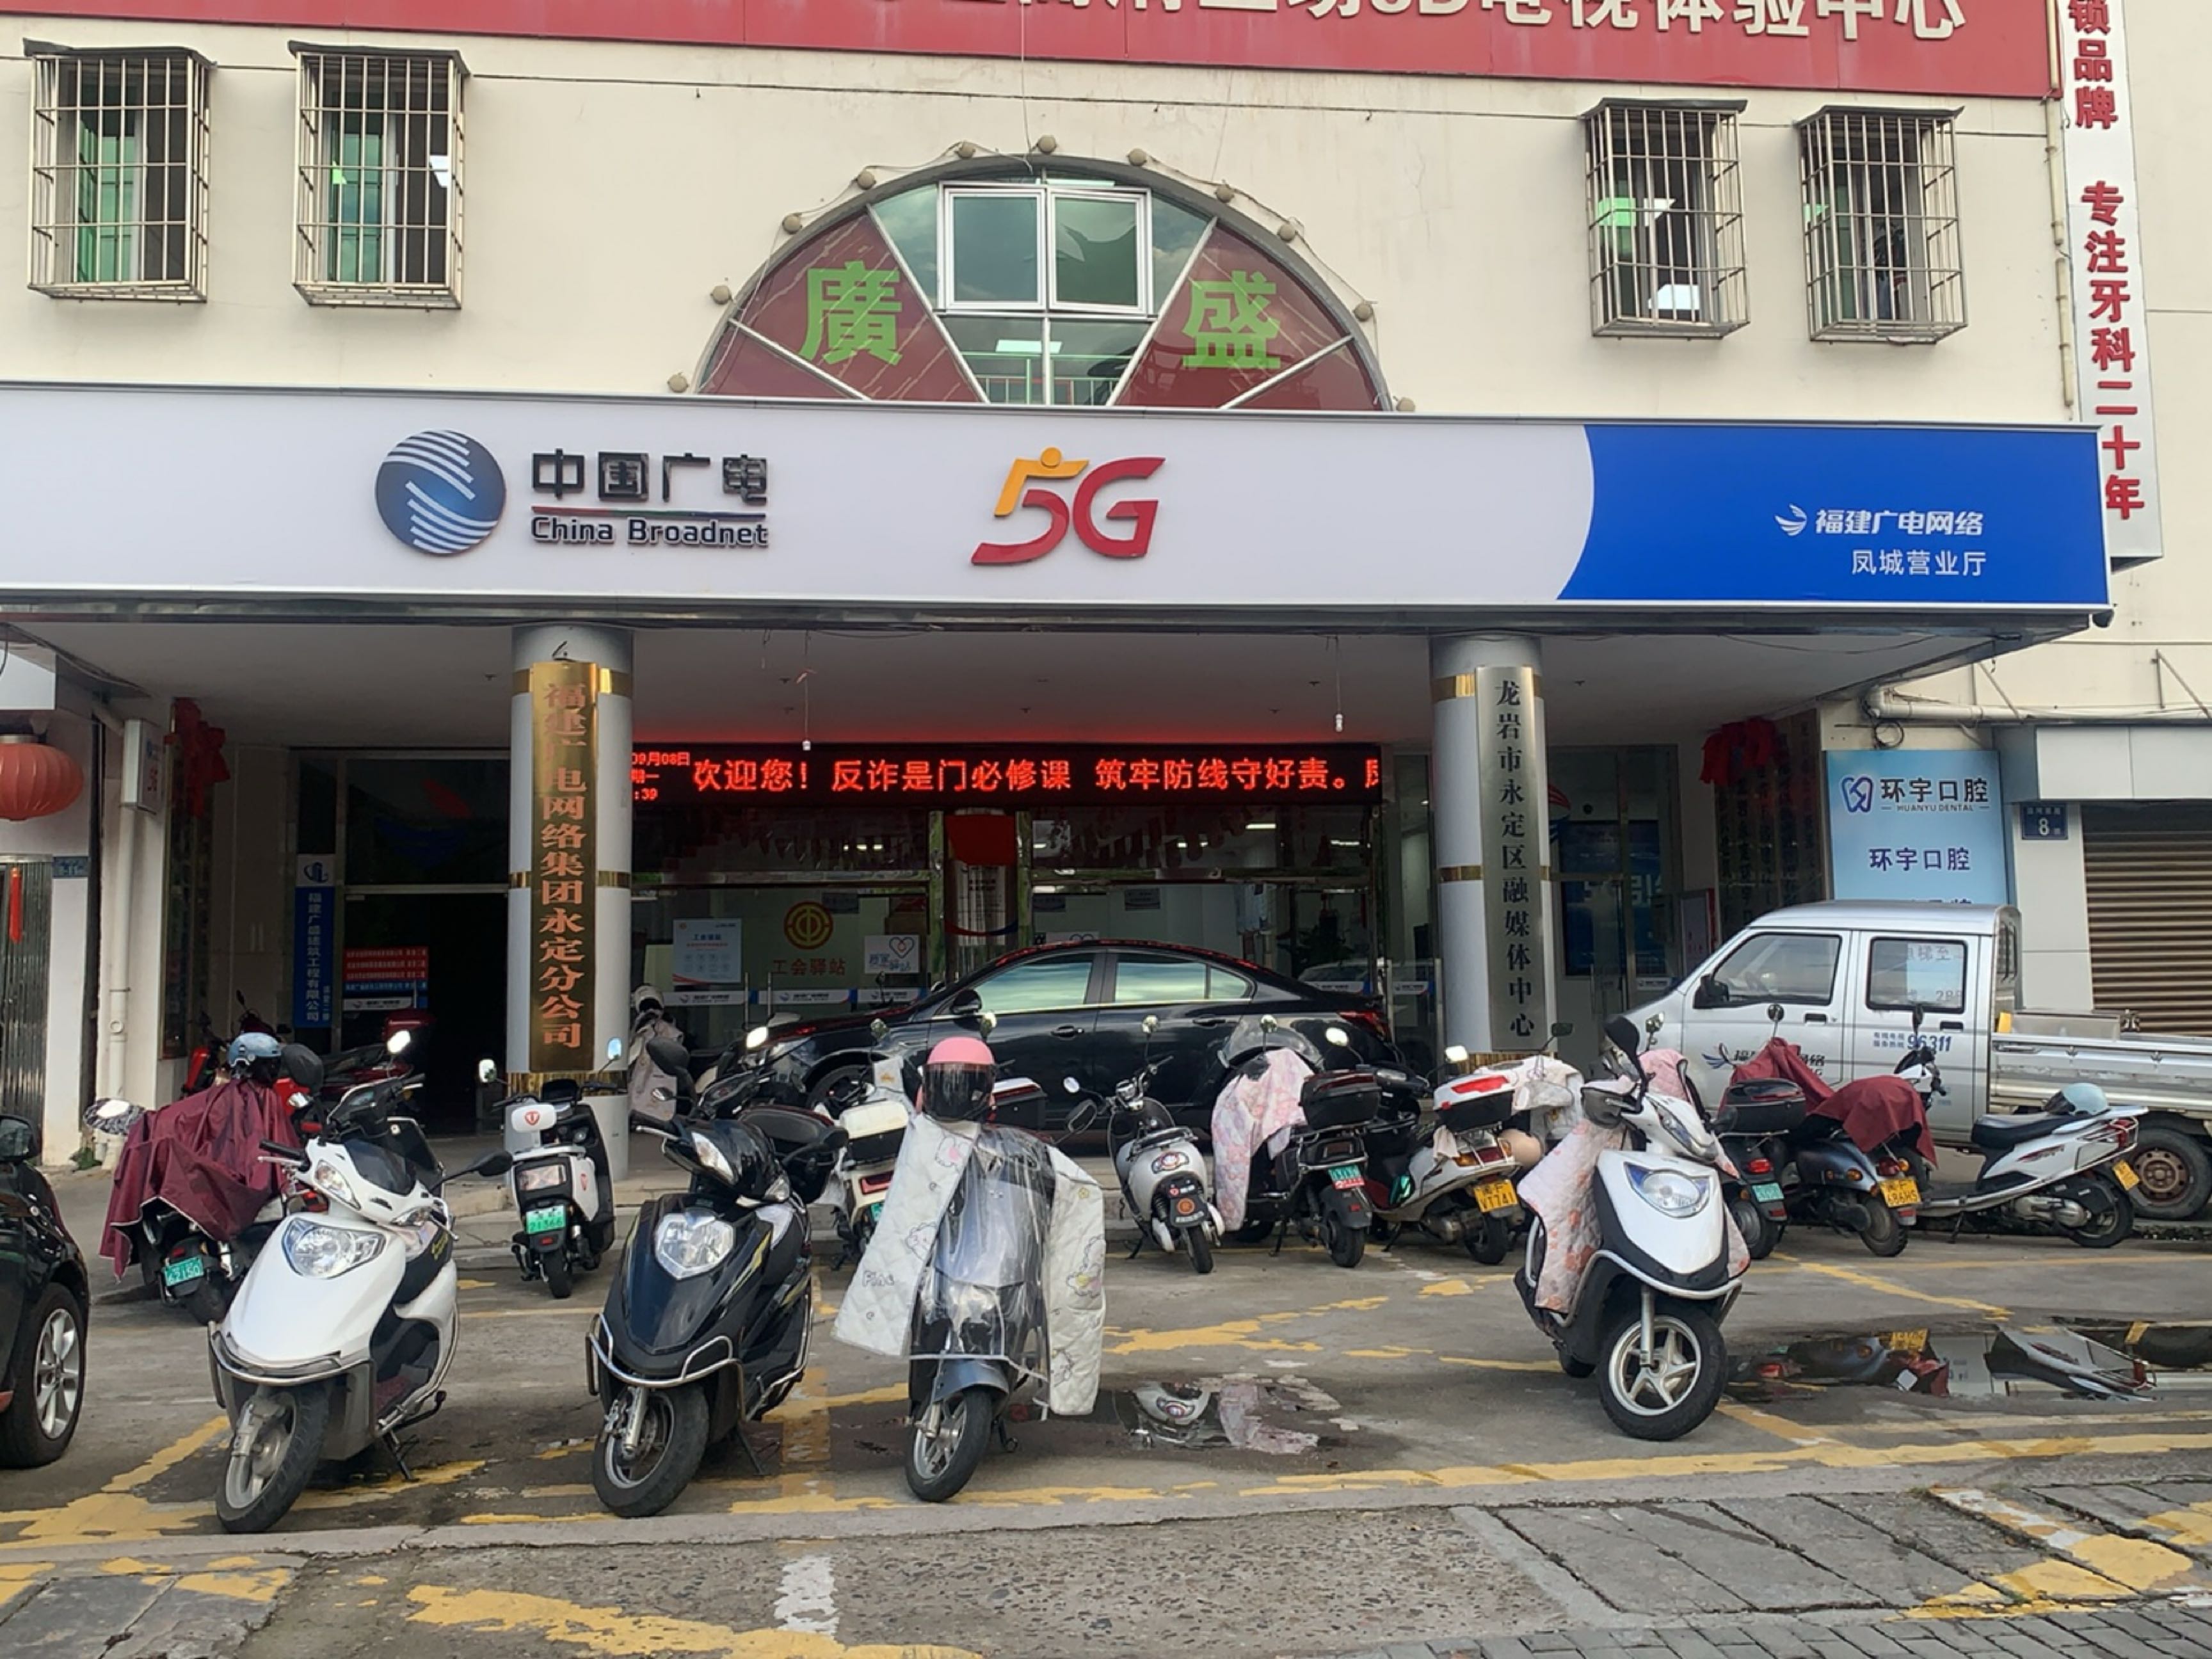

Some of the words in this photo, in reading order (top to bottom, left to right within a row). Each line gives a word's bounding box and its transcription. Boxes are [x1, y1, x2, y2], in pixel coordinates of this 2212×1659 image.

[798, 260, 902, 367] 廣
[1182, 270, 1279, 370] 盛
[2081, 181, 2145, 520] 专注牙科二十年
[532, 447, 767, 506] 中国广电
[970, 447, 1166, 566] 5G
[1815, 509, 1984, 536] 福建广电网络
[531, 517, 614, 543] China
[627, 519, 769, 548] Broadnet
[1852, 549, 1986, 576] 凤城营业厅
[831, 758, 1071, 792] 反诈是门必修课
[1880, 777, 1989, 803] 环宇口腔
[1495, 679, 1534, 1037] 龙岩市永定区融媒体中心
[1868, 847, 1971, 872] 环宇口腔
